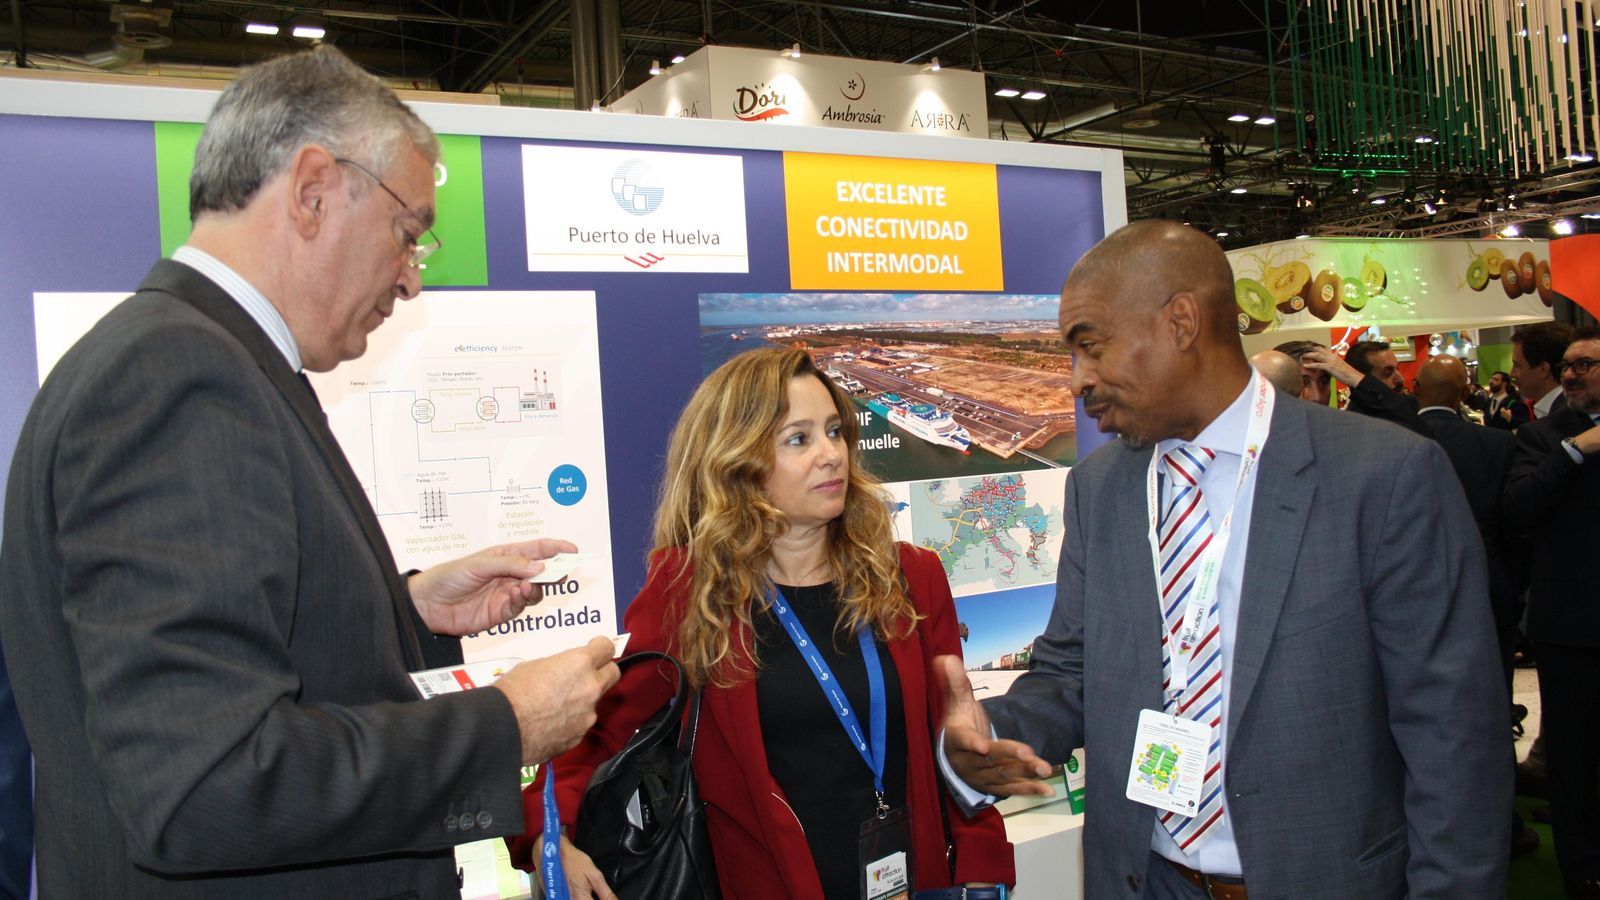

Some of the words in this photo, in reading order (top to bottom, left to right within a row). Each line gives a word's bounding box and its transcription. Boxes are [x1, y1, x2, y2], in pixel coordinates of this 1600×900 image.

[821, 104, 882, 125] Ambrosia
[836, 180, 947, 207] EXCELENTE
[568, 226, 629, 244] Puerto
[634, 226, 656, 244] de
[662, 228, 720, 246] Huelva
[816, 215, 968, 242] CONECTIVIDAD
[827, 251, 964, 275] INTERMODAL
[566, 485, 579, 493] Gas
[405, 535, 449, 544] Vaporizador
[513, 528, 540, 537] medida
[422, 545, 441, 553] agua
[487, 605, 602, 635] controlada
[1189, 607, 1204, 644] attraction
[547, 862, 555, 888] Puerto
